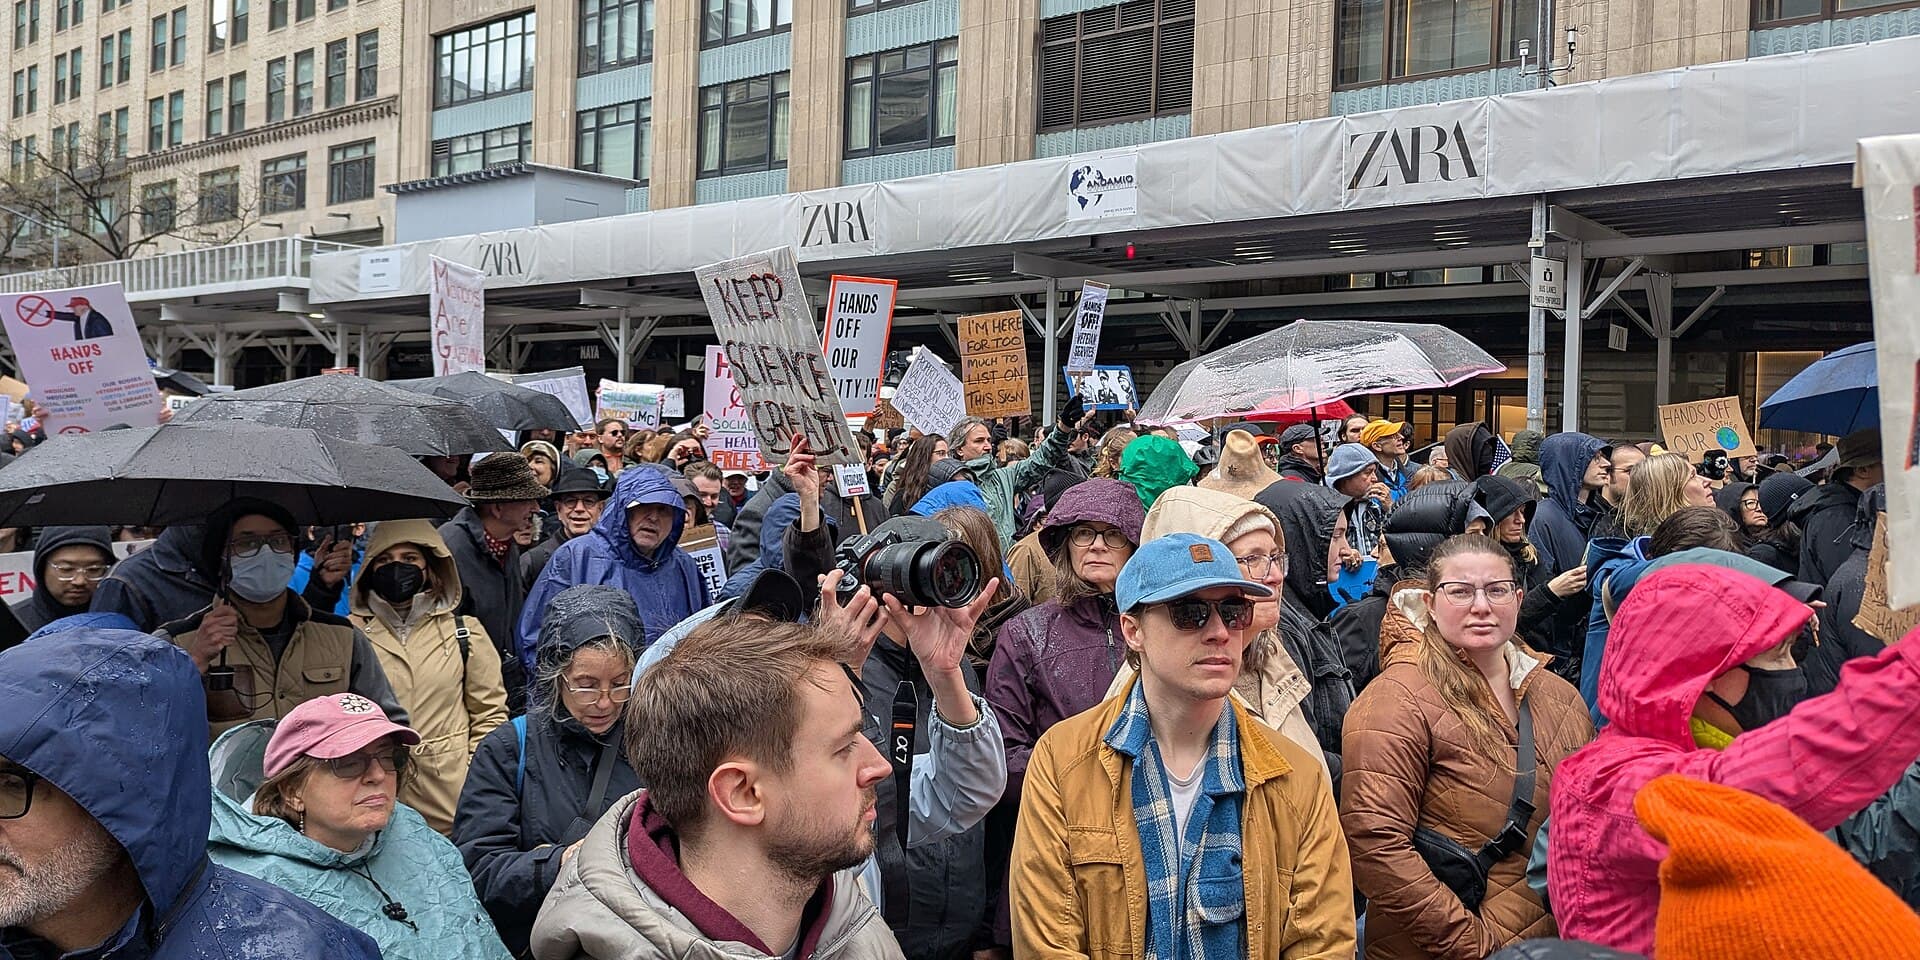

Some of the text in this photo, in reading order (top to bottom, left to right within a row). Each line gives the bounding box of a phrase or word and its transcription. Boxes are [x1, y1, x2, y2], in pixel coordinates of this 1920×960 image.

[1347, 120, 1482, 190] ZARA
[1087, 175, 1134, 188] ANDAMIO
[801, 198, 872, 247] ZARA
[480, 241, 523, 278] ZARA
[714, 273, 783, 328] KEEP
[838, 292, 878, 314] HANDS
[1083, 301, 1102, 312] HANDS
[836, 318, 861, 339] OFF
[968, 316, 1023, 336] I'M HERE
[1081, 312, 1100, 330] OFF!
[967, 336, 1022, 353] FOR TOO
[1076, 332, 1098, 345] VETERAN
[50, 343, 102, 361] HANDS
[580, 345, 600, 360] NAYA
[832, 348, 858, 369] OUR
[967, 354, 1018, 369] MUCH TO
[68, 360, 95, 375] OFF
[726, 340, 830, 402] SCIENCE
[967, 365, 1024, 386] LIST ON
[966, 389, 1024, 409] THIS SIGN
[1662, 400, 1731, 428] HANDS OFF
[713, 419, 752, 431] SOCIAL
[1709, 420, 1738, 434] MOTHER
[725, 437, 758, 448] HEALT
[1673, 432, 1712, 454] OUR
[711, 450, 752, 470] FREE
[858, 540, 872, 553] SONY
[695, 553, 714, 563] NDS
[896, 735, 909, 765] α7
